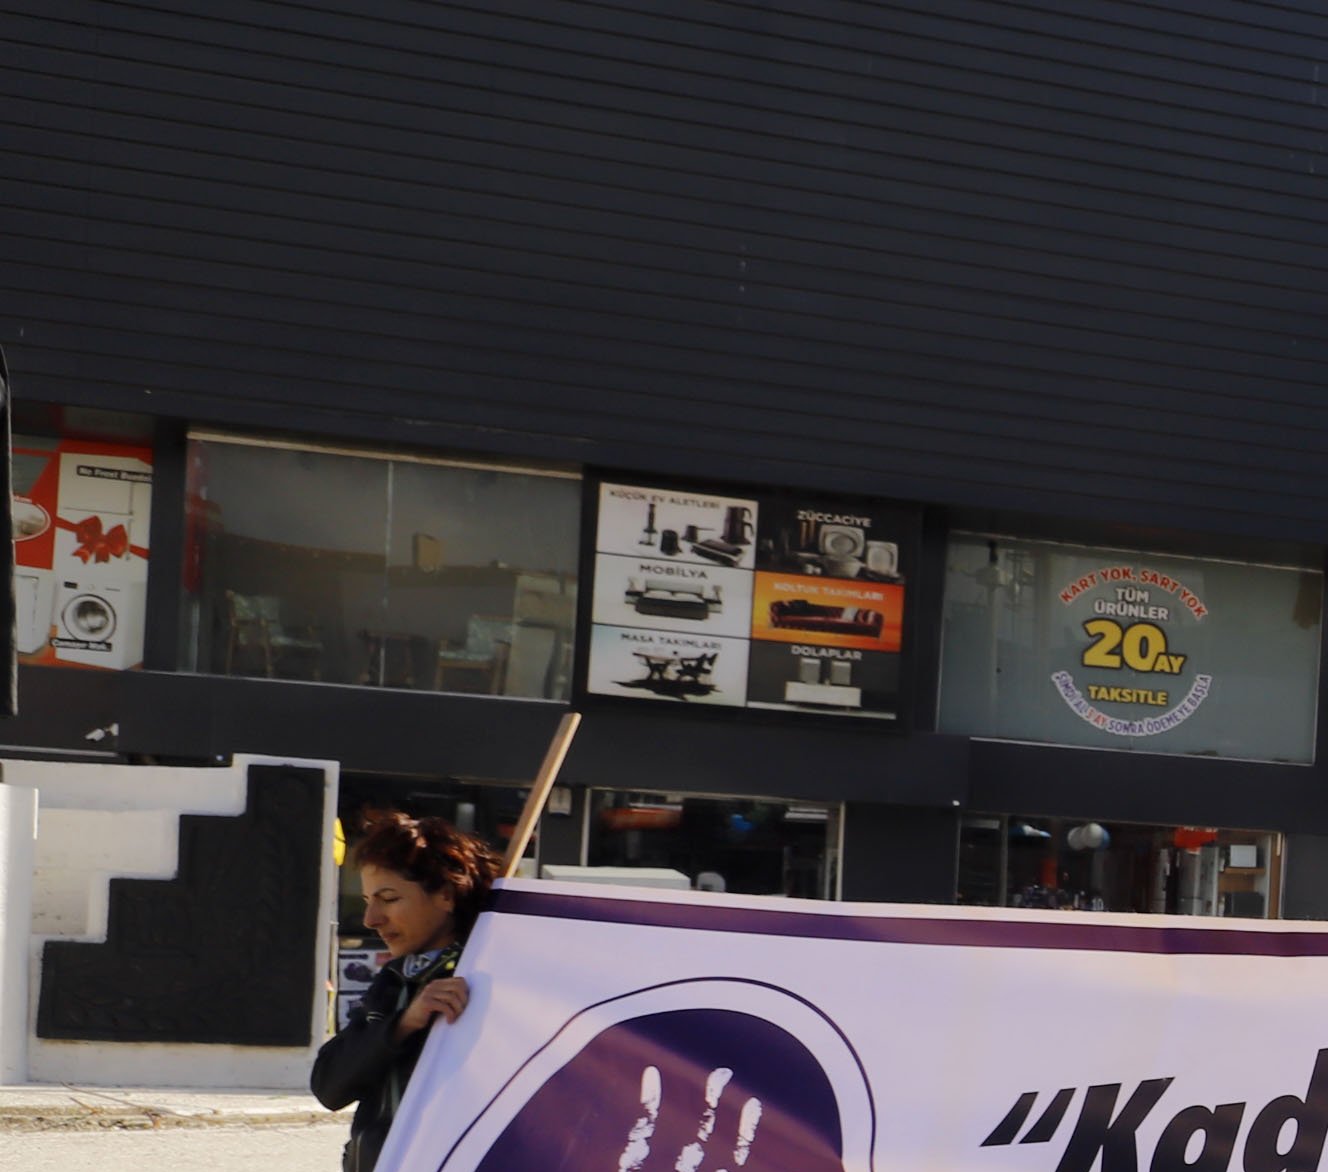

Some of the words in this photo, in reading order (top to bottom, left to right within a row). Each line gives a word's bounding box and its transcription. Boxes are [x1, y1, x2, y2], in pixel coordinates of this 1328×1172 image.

[638, 563, 709, 580] MOBİLYA
[1059, 573, 1098, 605] KART
[1180, 587, 1208, 619] YOK
[1116, 587, 1149, 604] TÜM
[1094, 600, 1169, 620] ÜRÜNLER
[790, 645, 862, 661] DOLAPLAR
